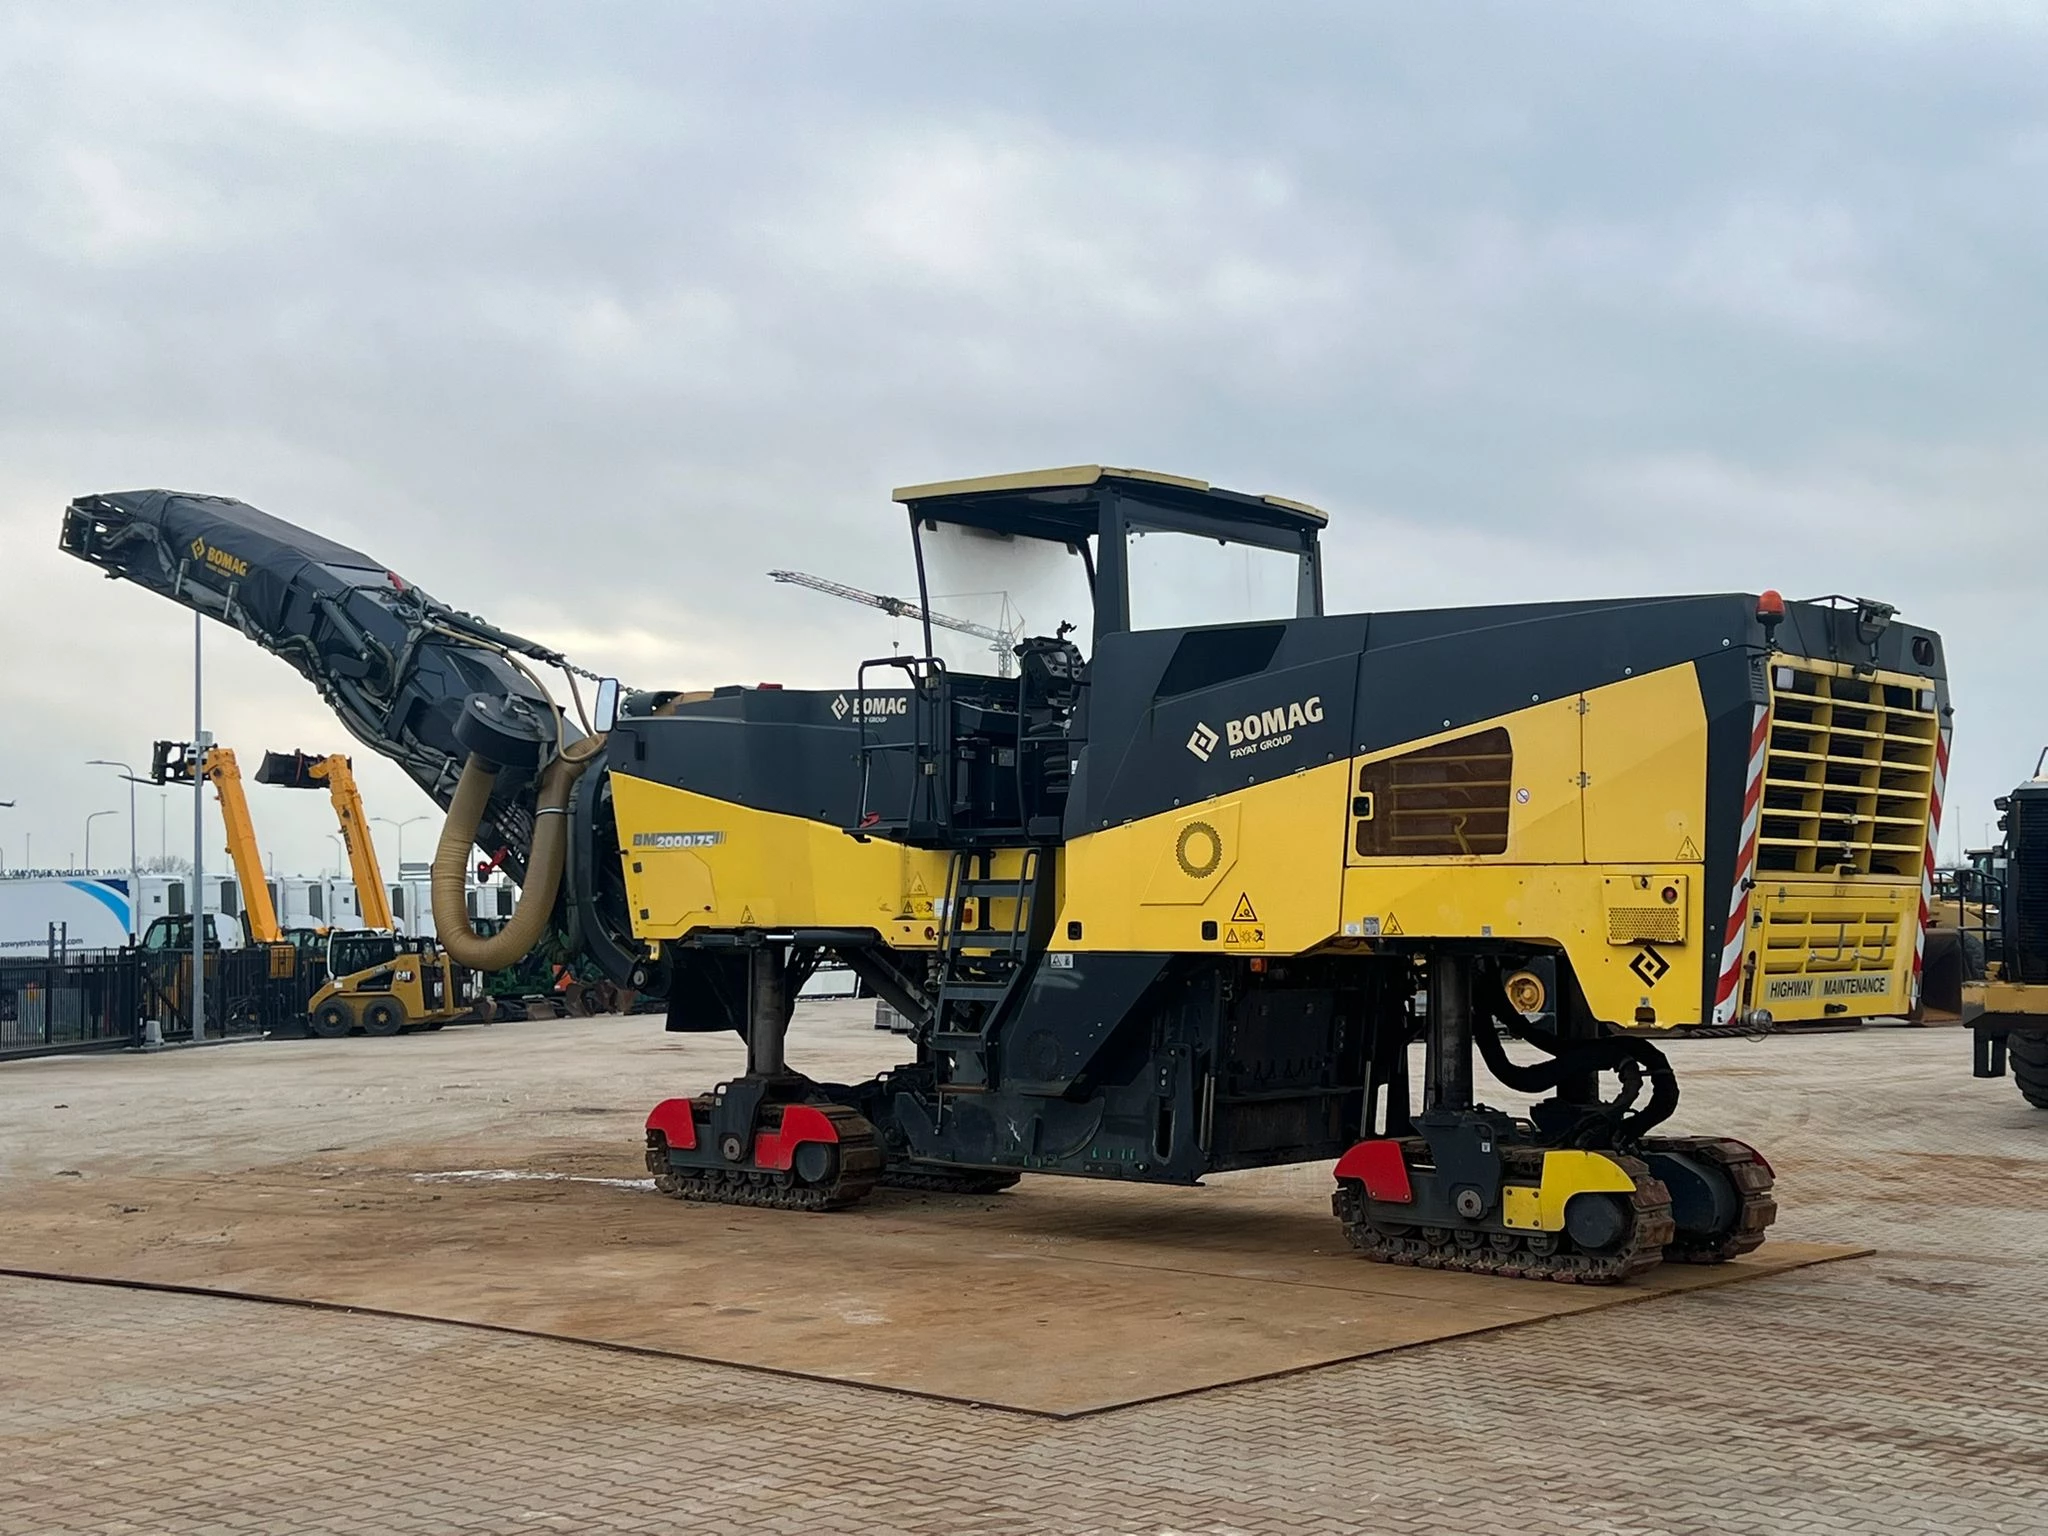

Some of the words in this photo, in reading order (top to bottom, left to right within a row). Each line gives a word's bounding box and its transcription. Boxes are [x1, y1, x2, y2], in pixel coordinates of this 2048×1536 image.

[207, 546, 248, 577] BOMAG
[852, 697, 907, 715] BOMAG
[1226, 696, 1324, 746] BOMAG
[1229, 743, 1258, 759] FAYAT
[1259, 734, 1293, 751] GROUP
[396, 971, 412, 981] CAT
[1770, 979, 1814, 998] HIGHWAY
[1823, 977, 1886, 995] MAINTENANCE
